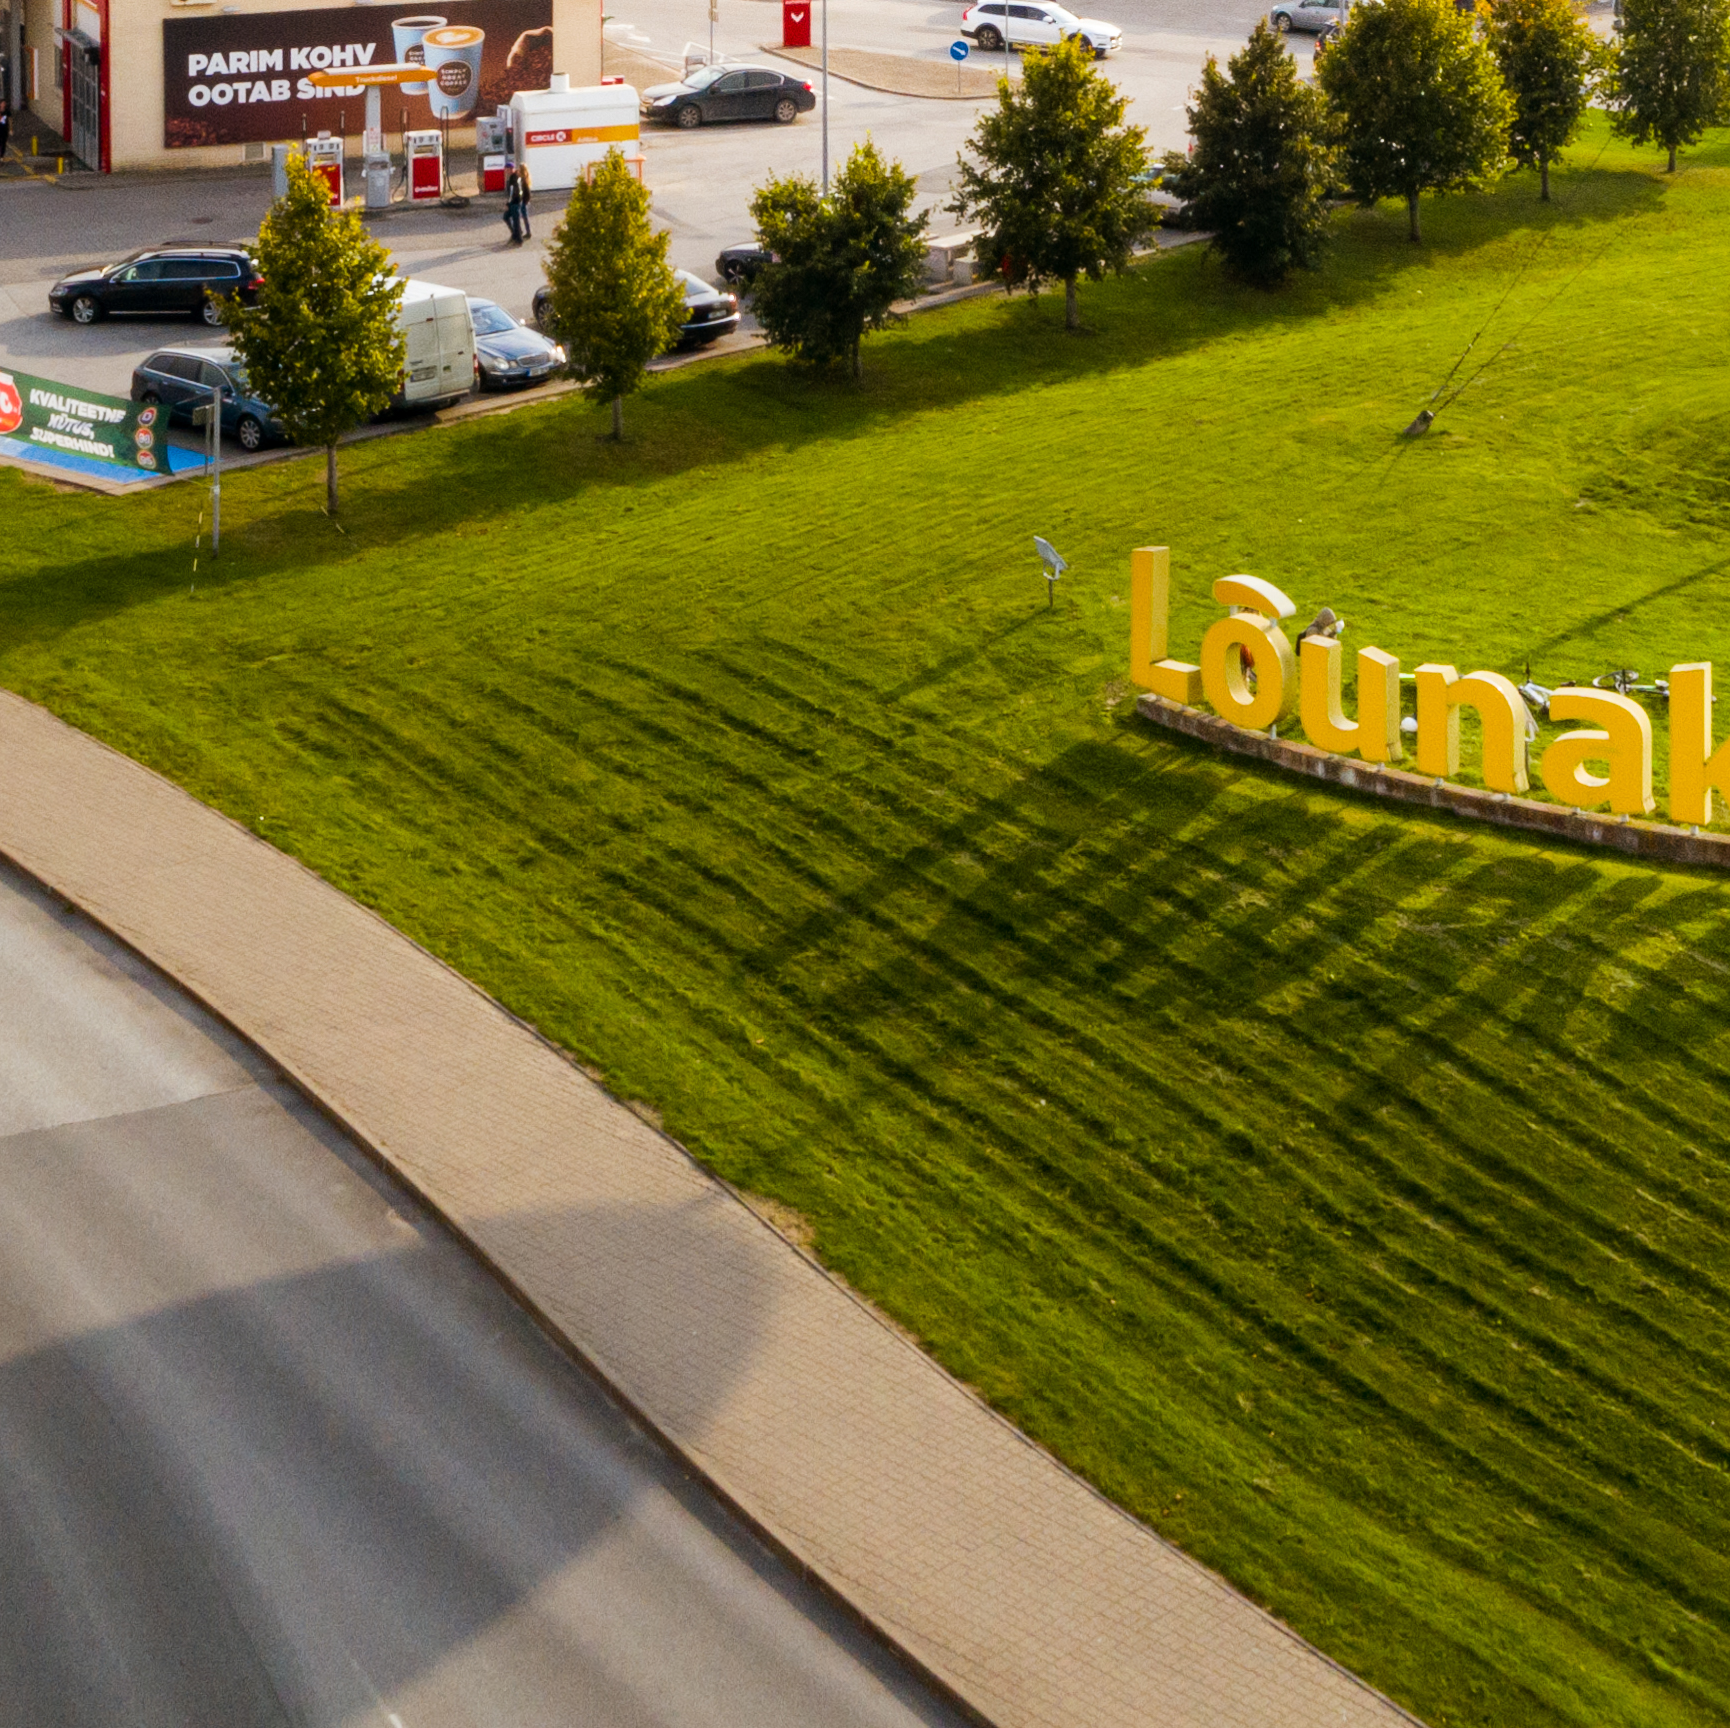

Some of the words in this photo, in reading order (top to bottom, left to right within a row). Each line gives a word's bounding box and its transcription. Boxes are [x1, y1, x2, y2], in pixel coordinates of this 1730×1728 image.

[188, 49, 288, 77] PARIM
[290, 42, 377, 71] KOHV
[188, 78, 291, 107] OOTAB
[530, 133, 555, 142] CIRCLE
[29, 388, 127, 424] KVALITEETNE
[30, 426, 115, 458] SUPERHIND!
[47, 413, 95, 441] KÜTUS,
